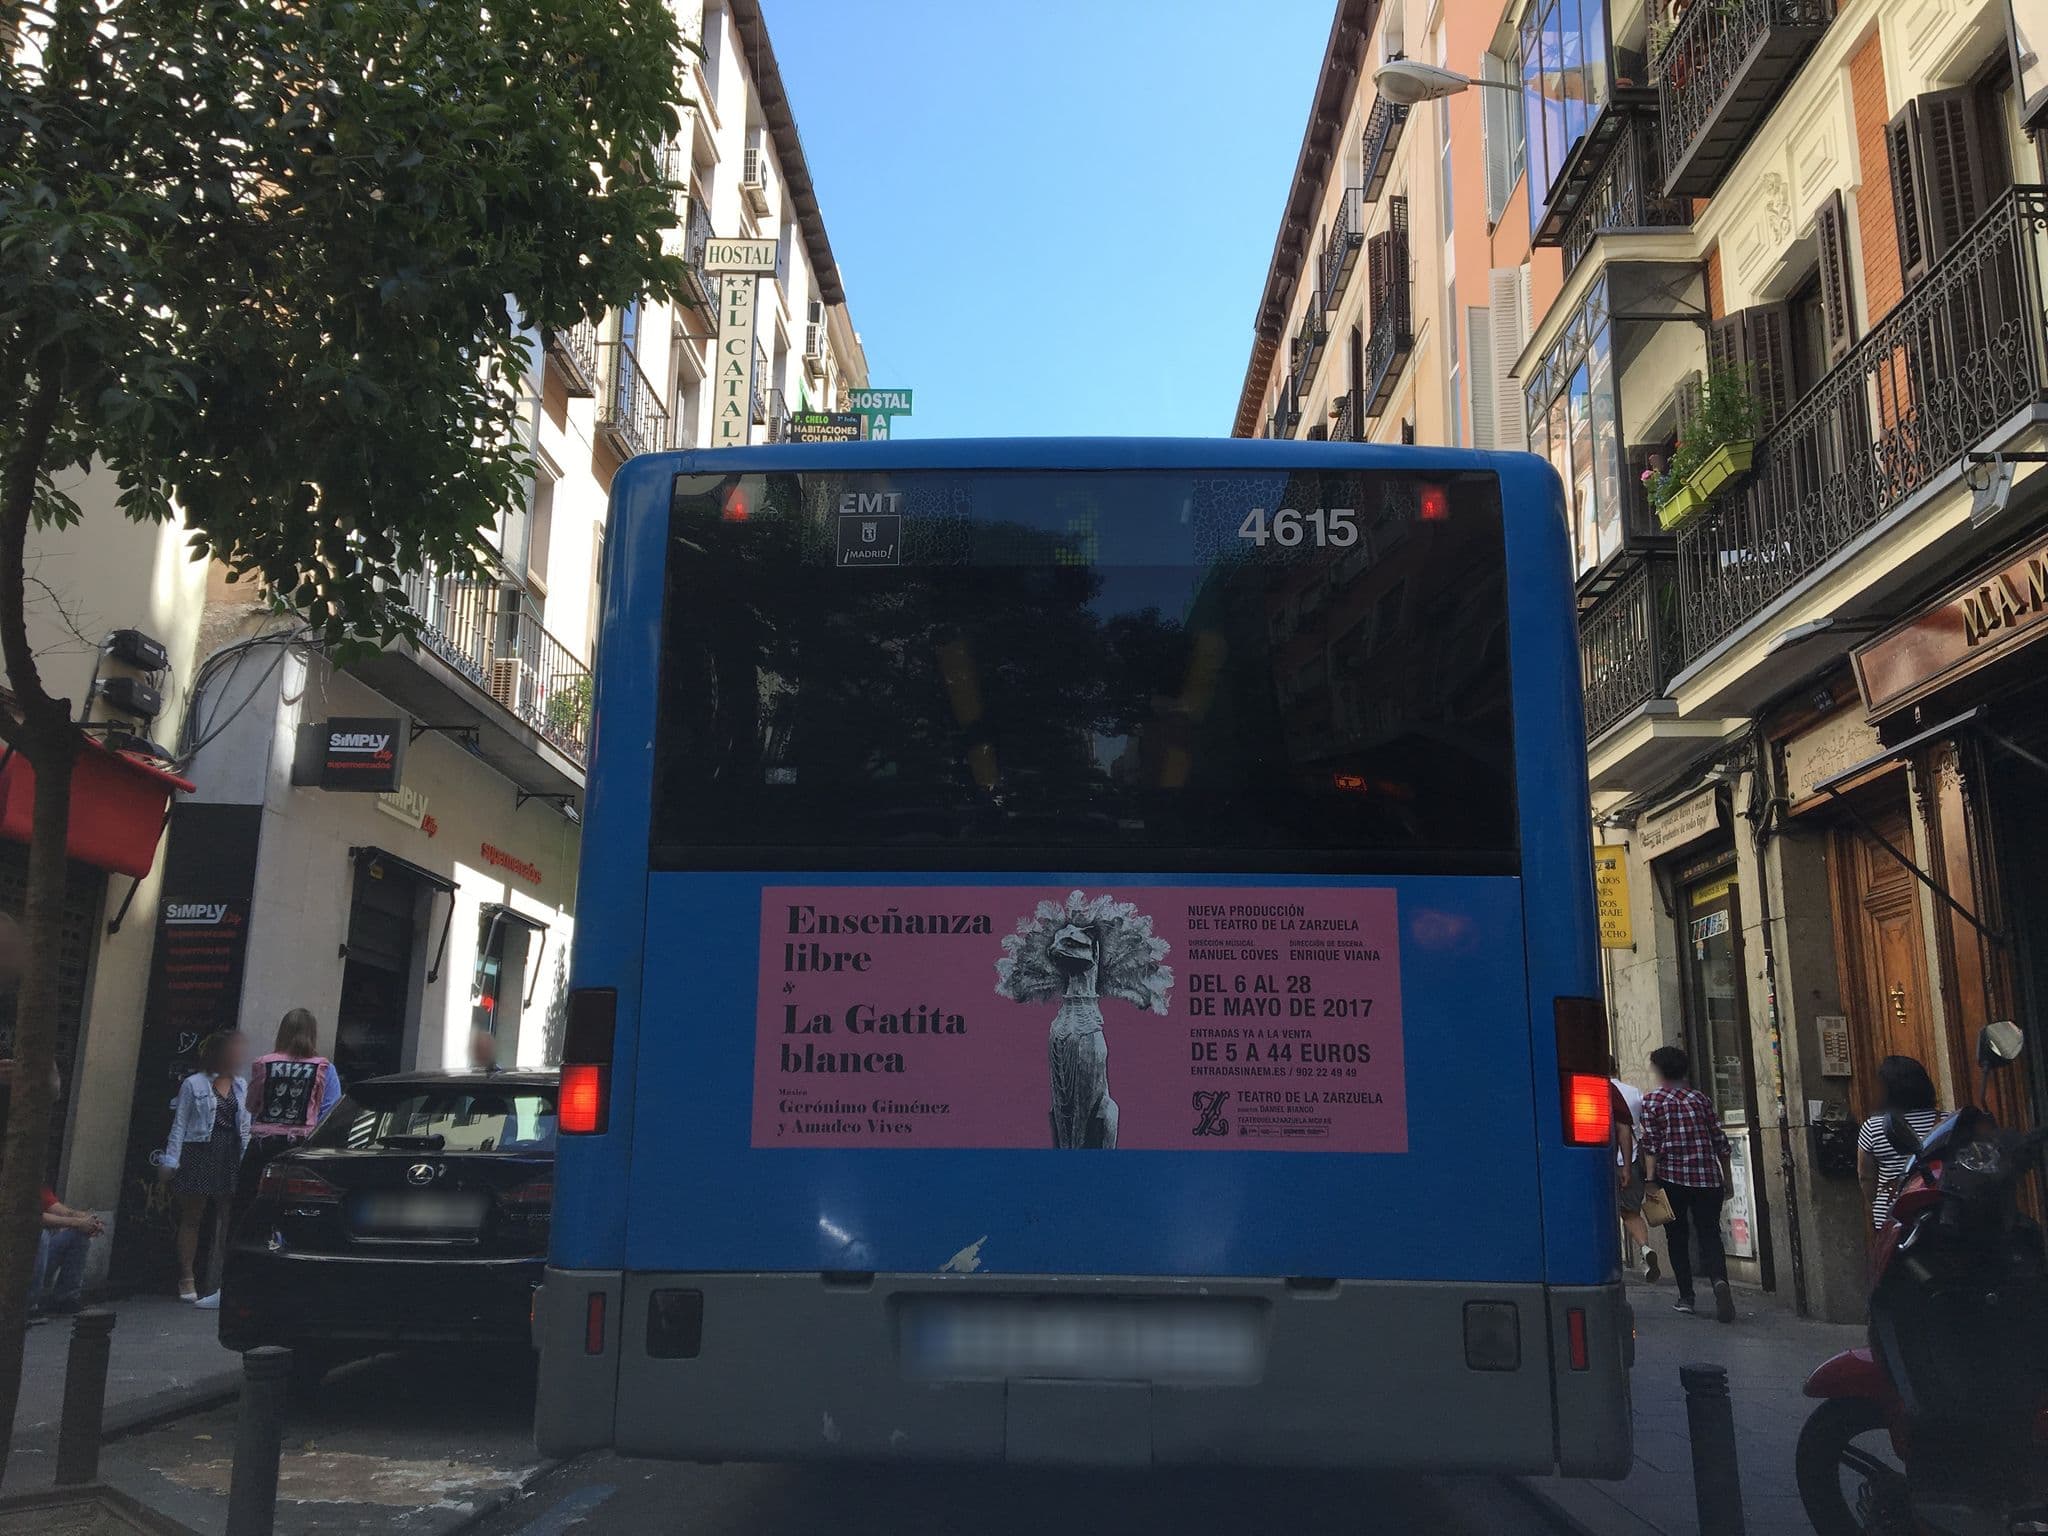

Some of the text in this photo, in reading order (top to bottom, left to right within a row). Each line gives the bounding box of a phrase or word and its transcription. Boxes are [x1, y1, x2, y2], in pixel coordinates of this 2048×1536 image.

[708, 245, 773, 265] HOSTAL
[721, 289, 747, 447] EL CATAL
[850, 393, 910, 409] HOSTAL
[805, 415, 829, 424] CHELO
[793, 425, 858, 435] HABITACIONES
[800, 434, 822, 442] CON
[839, 493, 902, 513] EMT
[1238, 508, 1359, 547] 4615
[843, 544, 894, 564] ¡MADRID!
[1188, 903, 1305, 917] NUEVA PRODUCCIÓN
[787, 905, 993, 935] Enseñanza
[1188, 919, 1359, 931] DEL TEATRO DE LA ZARZUELA
[783, 942, 872, 972] libre
[1189, 949, 1279, 961] MANUEL COVES
[1290, 950, 1380, 962] ENRIQUE VIANA
[1189, 974, 1311, 994] DEL 6 AL 28
[1189, 998, 1373, 1018] DE MAYO DE 2017
[783, 1003, 968, 1035] La Gatita
[1190, 1029, 1312, 1039] ENTRADAS YA A LA VENTA
[780, 1043, 906, 1073] blanca
[1191, 1042, 1371, 1063] DE 5 A 44 EUROS
[270, 1062, 316, 1079] KISS
[1191, 1067, 1286, 1077] ENTRADASINAEM.ES
[1315, 1068, 1328, 1077] 22
[1238, 1091, 1383, 1104] TEATRO DE LA ZARZUELA
[778, 1098, 951, 1115] Gerónimo Giménez
[1260, 1105, 1285, 1113] DANIEL
[777, 1118, 913, 1136] y Amadeo Vives
